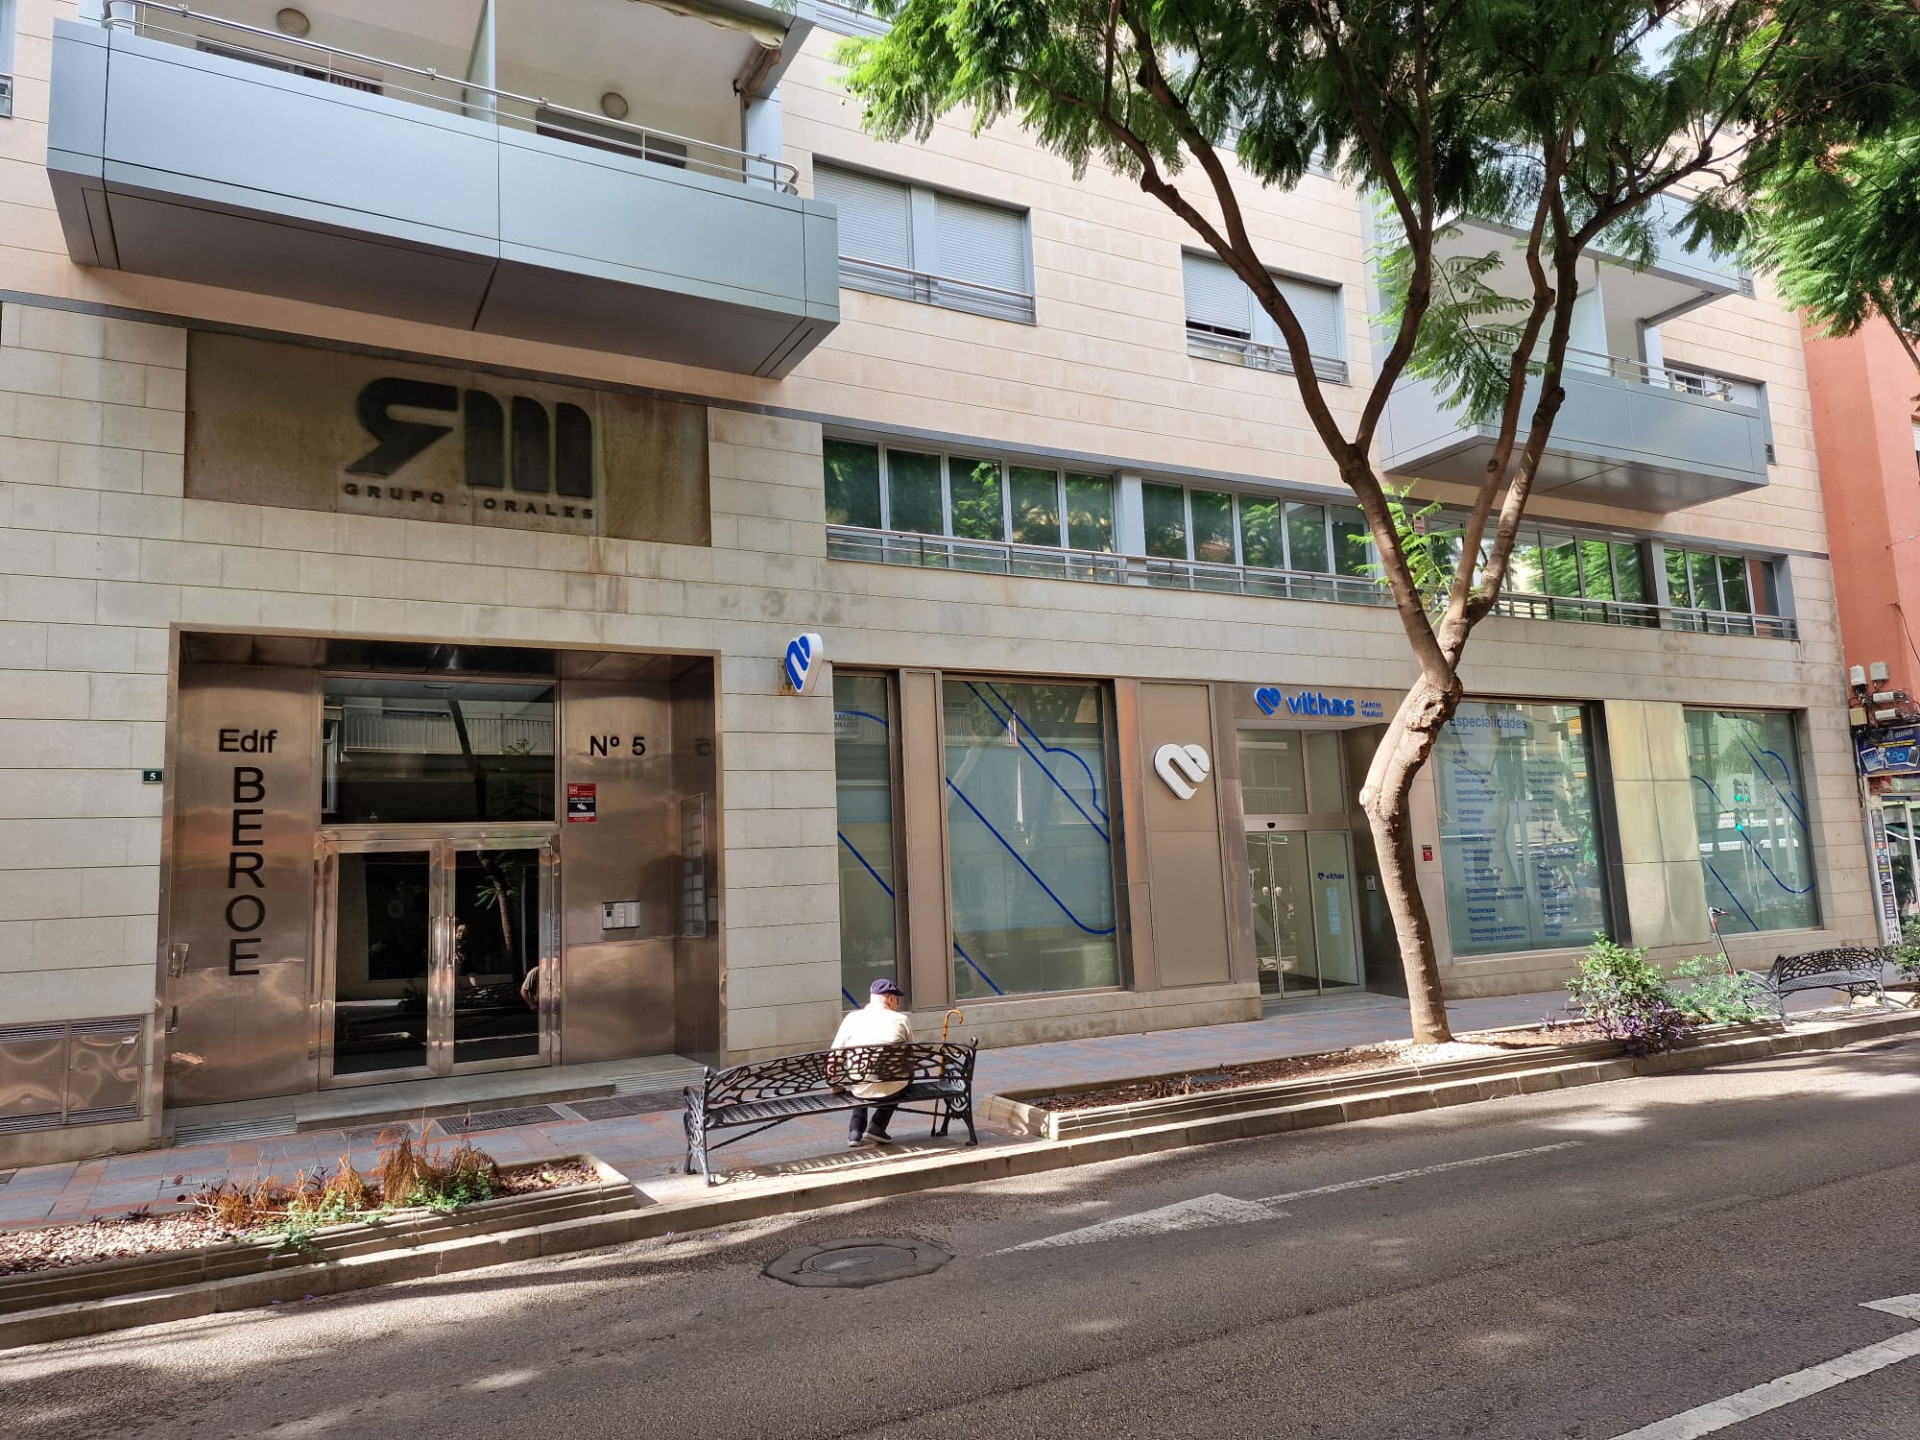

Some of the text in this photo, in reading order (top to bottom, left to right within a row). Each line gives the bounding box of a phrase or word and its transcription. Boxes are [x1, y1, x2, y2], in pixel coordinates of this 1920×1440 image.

[343, 483, 444, 504] GRUPO
[1286, 691, 1355, 717] vithas
[1360, 700, 1382, 708] Centro
[1450, 715, 1528, 730] Especialidades
[219, 729, 277, 752] Edif
[632, 736, 646, 756] 5
[150, 772, 156, 780] 5
[226, 767, 265, 976] BEROE
[1326, 872, 1345, 880] vithas
